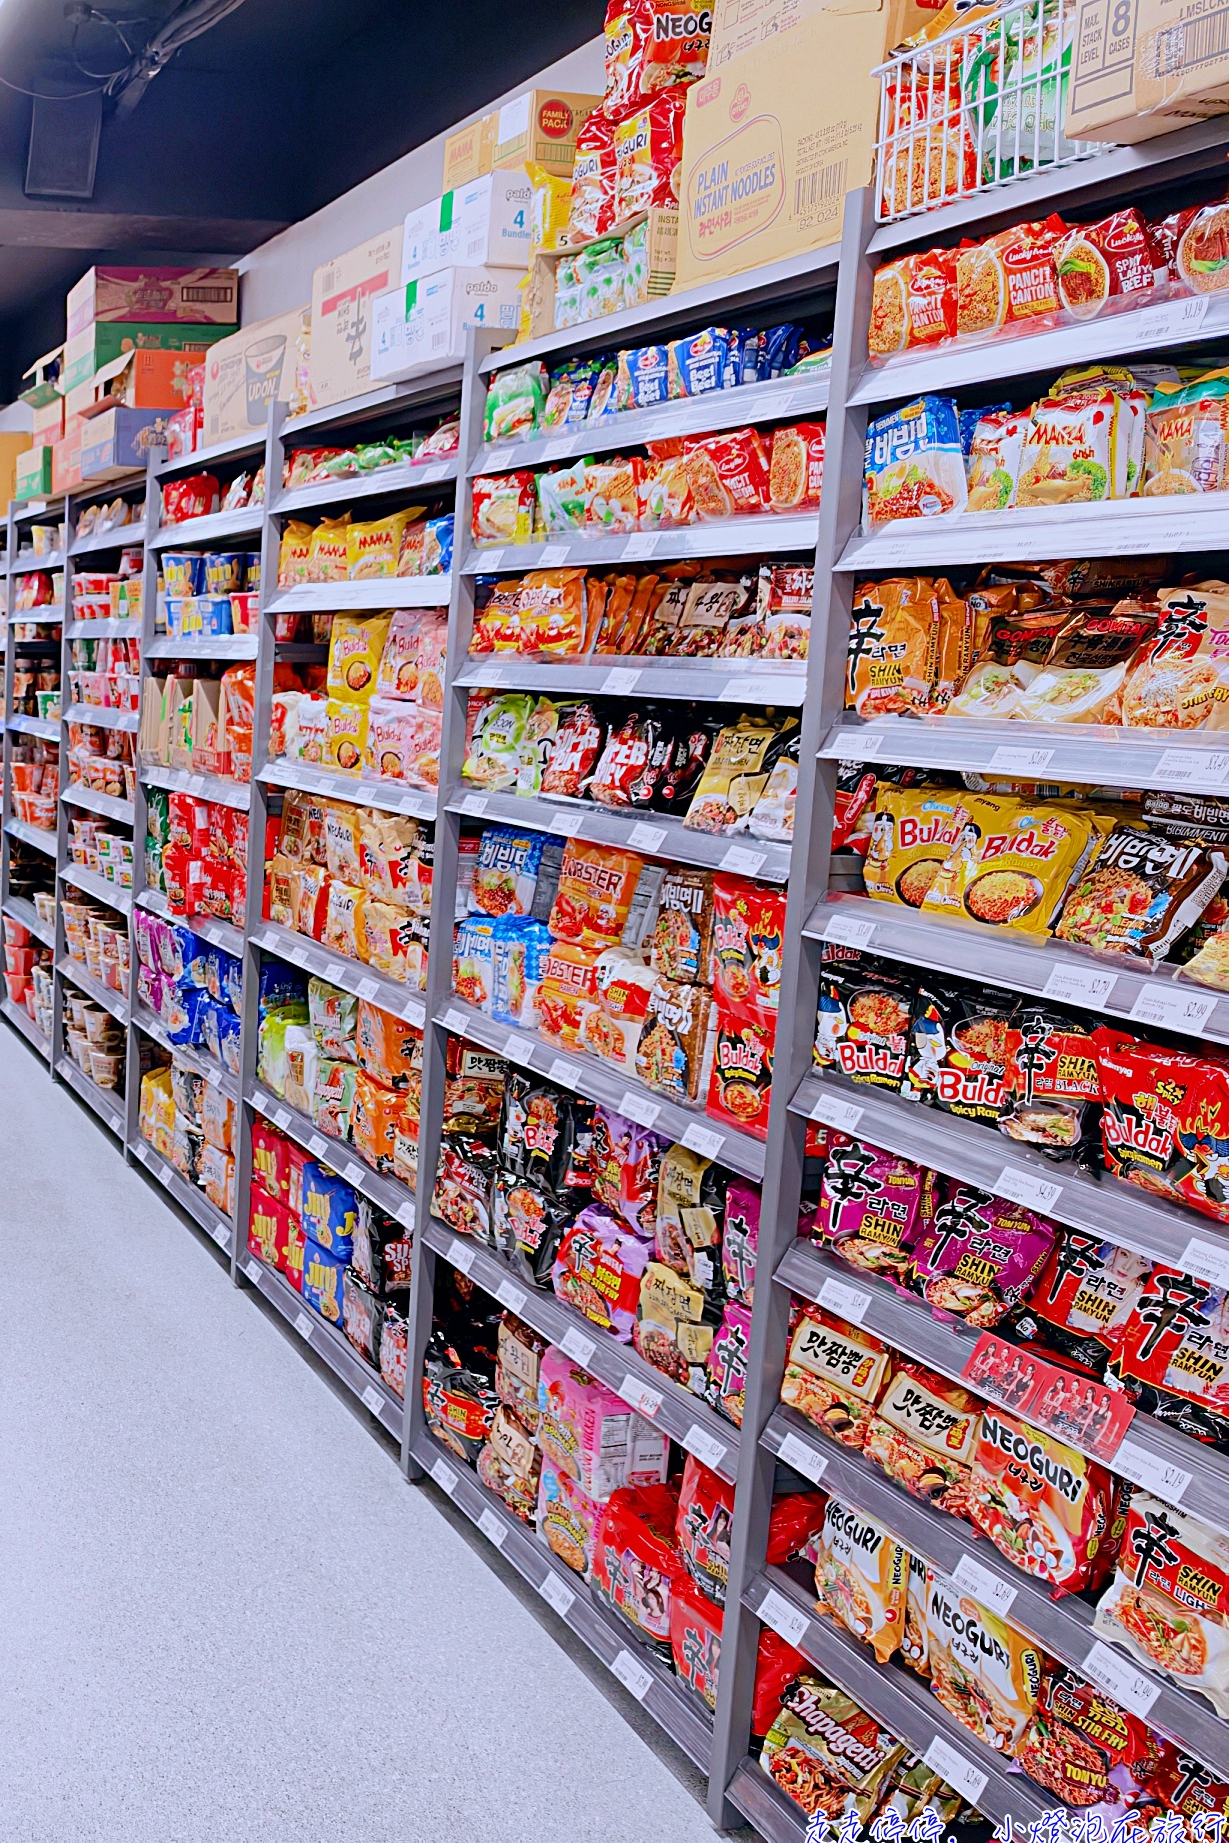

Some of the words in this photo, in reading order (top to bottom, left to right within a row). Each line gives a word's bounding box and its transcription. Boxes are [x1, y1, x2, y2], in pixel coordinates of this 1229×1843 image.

[656, 11, 712, 40] NEOG
[1084, 12, 1100, 30] MAX.
[1112, 0, 1131, 37] 8
[1082, 28, 1103, 47] STACK
[1109, 36, 1130, 55] CASES
[1080, 47, 1100, 65] LEVEL
[542, 109, 569, 119] FAMILY
[542, 119, 569, 129] PACK
[697, 161, 729, 194] PLAIN
[694, 185, 729, 220] INSTANT
[731, 163, 776, 203] NOODLES
[514, 210, 524, 228] 4
[698, 209, 732, 238] 라면사리
[800, 216, 813, 230] 92
[817, 208, 838, 223] 024
[466, 281, 498, 295] paldo
[1008, 266, 1052, 290] PANCIT
[1121, 278, 1153, 293] BEEF
[1010, 282, 1055, 304] CANTON
[474, 303, 485, 321] 4
[691, 368, 714, 380] Beef
[248, 378, 277, 398] UDON
[358, 531, 393, 550] MAMA
[848, 597, 887, 694] 辛
[869, 662, 903, 679] SHIN
[870, 675, 905, 687] RAMYUN
[1040, 817, 1068, 839] 불닭
[561, 855, 624, 897] LOBSTER
[1088, 978, 1111, 995] $2.79
[1183, 1001, 1208, 1019] $2.99
[721, 1043, 761, 1073] Buldak
[971, 1061, 1006, 1075] Original
[1015, 1015, 1057, 1106] 辛
[1057, 1055, 1097, 1071] SHIN
[870, 1075, 901, 1088] Ramen
[1057, 1067, 1099, 1083] RAMYUN
[938, 1068, 1006, 1107] Buld
[1055, 1079, 1099, 1096] BLACK
[1155, 1080, 1181, 1105] Spicy
[1166, 1077, 1185, 1097] 2x
[949, 1104, 976, 1118] Spicy
[817, 1129, 827, 1144] 5
[1104, 1108, 1171, 1160] Buldak
[567, 1171, 576, 1184] 5
[823, 1142, 884, 1231] 辛
[1036, 1186, 1056, 1200] $4.39
[868, 1196, 909, 1221] 라면
[860, 1228, 899, 1247] RAMYUN
[862, 1214, 904, 1238] SHIN
[969, 1236, 1013, 1263] 라면
[960, 1253, 1002, 1276] SHIN
[1087, 1274, 1127, 1301] 라면
[1073, 1301, 1111, 1324] RAMYUN
[1077, 1290, 1117, 1316] SHIN
[1136, 1272, 1211, 1361] 辛
[800, 1330, 864, 1375] 맛짬뽕
[1187, 1331, 1229, 1359] 라면
[1172, 1358, 1216, 1383] RAMYUN
[1176, 1347, 1223, 1374] SHIN
[583, 1408, 596, 1448] CHICKEN
[981, 1414, 1084, 1504] NEOGURI
[1007, 1462, 1044, 1492] 너구리
[1161, 1467, 1185, 1488] $2.19
[824, 1500, 882, 1554] NEOGURI
[1132, 1512, 1181, 1589] 辛
[993, 1581, 1012, 1601] $2.69
[1178, 1578, 1217, 1604] RAMYUN
[1180, 1565, 1223, 1595] SHIN
[930, 1590, 1011, 1669] NEOGURI
[951, 1637, 979, 1665] 너구리
[1132, 1678, 1155, 1700] $2.99
[788, 1688, 885, 1773] Shapagetti
[1075, 1719, 1103, 1745] STIR
[1100, 1730, 1127, 1752] FRY
[963, 1768, 982, 1790] $2.69
